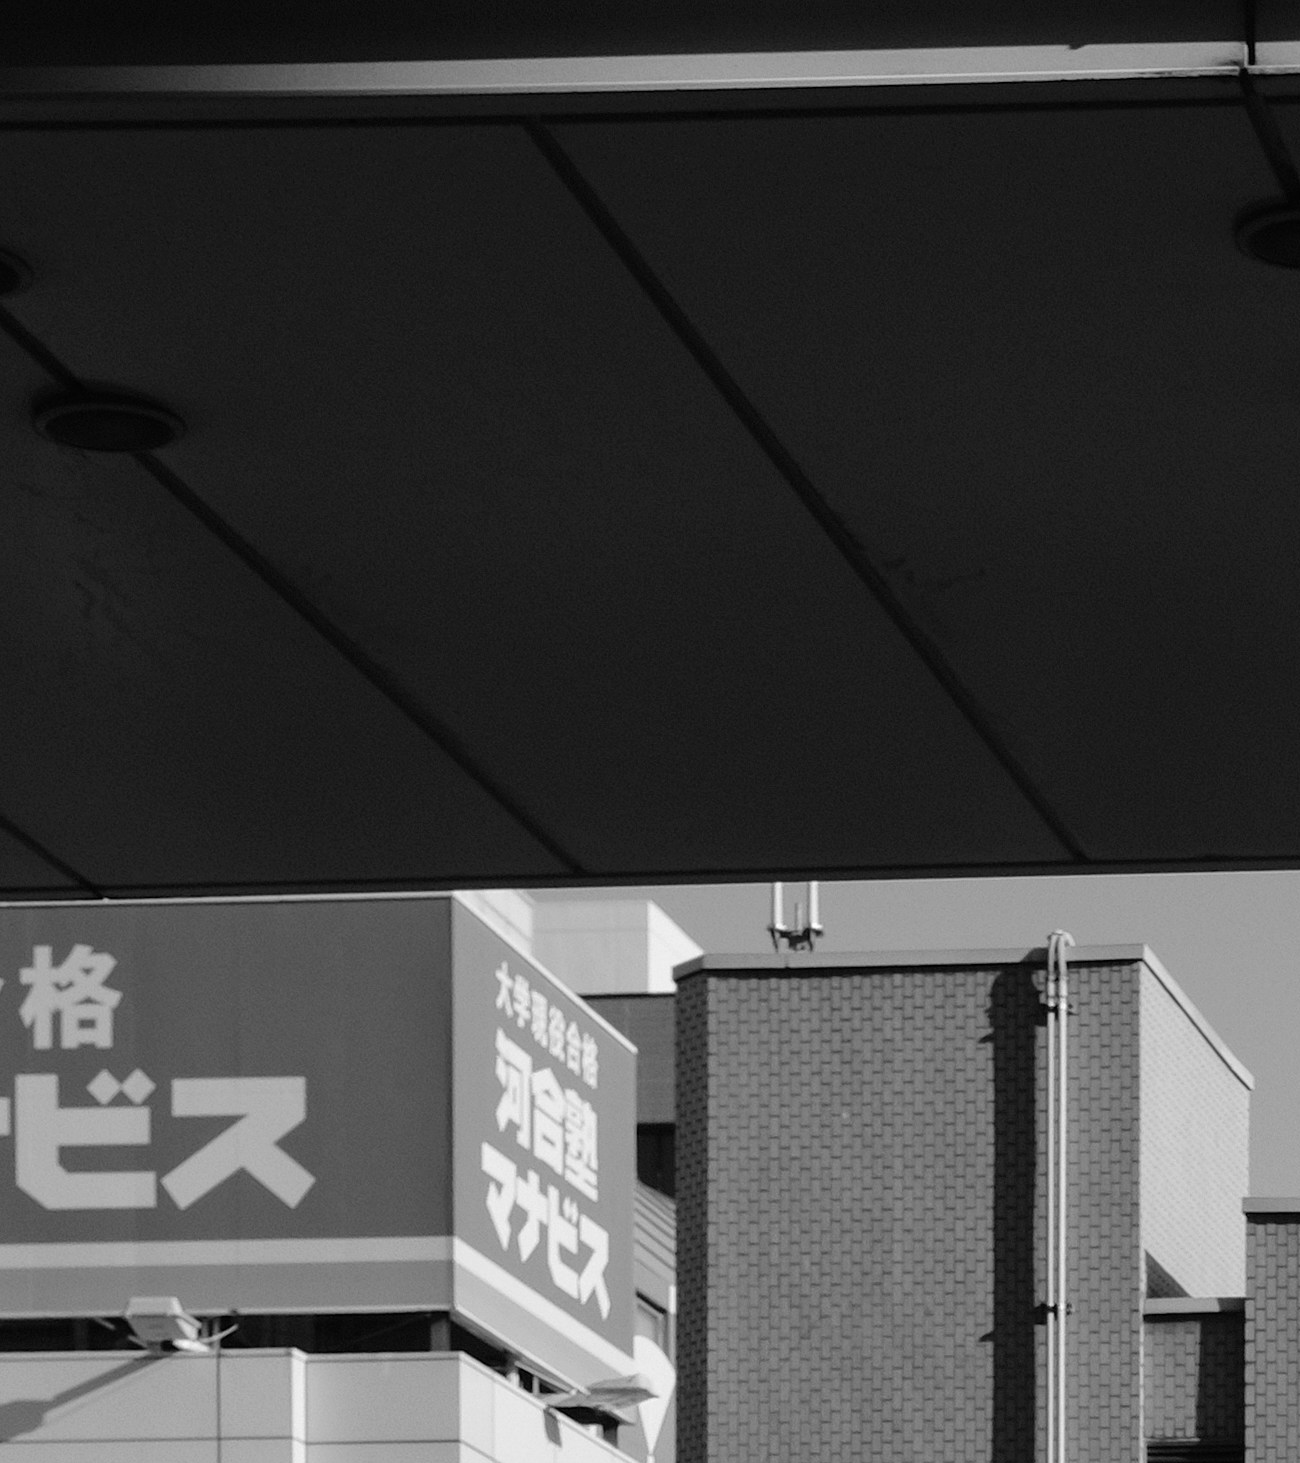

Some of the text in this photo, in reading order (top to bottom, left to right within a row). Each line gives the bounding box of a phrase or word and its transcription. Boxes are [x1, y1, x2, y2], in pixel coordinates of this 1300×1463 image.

[0, 943, 123, 1050] 格
[0, 1068, 316, 1211] ビス
[494, 1027, 599, 1202] 河合塾
[481, 1141, 611, 1321] マナビス
